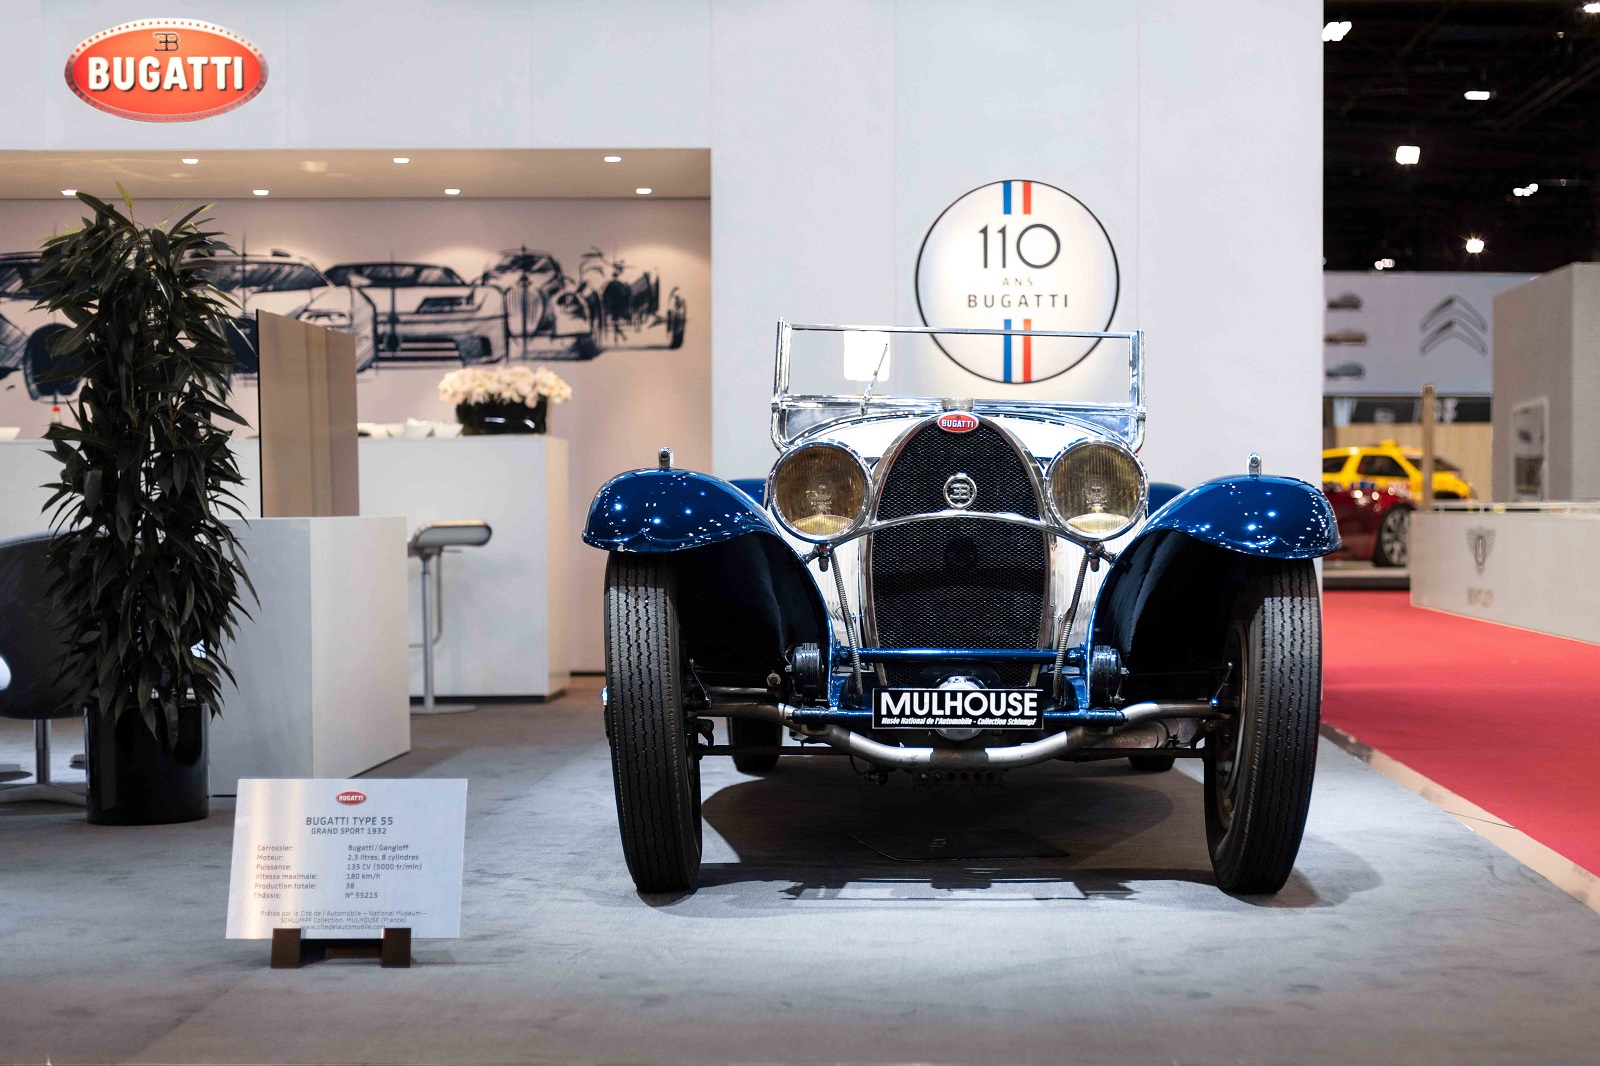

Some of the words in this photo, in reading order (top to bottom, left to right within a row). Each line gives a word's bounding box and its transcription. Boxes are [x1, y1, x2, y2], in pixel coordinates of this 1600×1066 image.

[88, 56, 245, 92] BUGATTI
[978, 223, 1061, 269] 110
[1002, 277, 1033, 286] ANS
[967, 294, 1068, 308] BUGATTI
[941, 419, 974, 428] BUGATTI
[880, 692, 1038, 716] MULHOUSE
[881, 717, 900, 725] Musée
[901, 717, 926, 725] National
[926, 717, 934, 725] de
[935, 717, 972, 725] l'Automobile
[977, 717, 1007, 726] Collection
[1007, 717, 1037, 726] Schlumpf
[306, 816, 349, 826] BUGATTI
[352, 816, 377, 826] TYPE
[380, 816, 393, 826] 55
[311, 827, 338, 835] GRAND
[340, 827, 364, 835] SPORT
[367, 827, 387, 835] 1932
[257, 844, 294, 852] Carrossier:
[347, 853, 358, 862] 2,3
[360, 853, 380, 862] litres,
[381, 853, 386, 861] 8
[387, 853, 419, 862] cylindres
[255, 863, 292, 871] Puissance:
[346, 863, 360, 871] 135
[362, 863, 371, 871] CV
[373, 862, 395, 871] (5000
[396, 862, 422, 871] tr/min)
[361, 872, 381, 880] km/h
[254, 882, 293, 890] Production
[294, 882, 317, 890] totale:
[345, 882, 355, 890] 38
